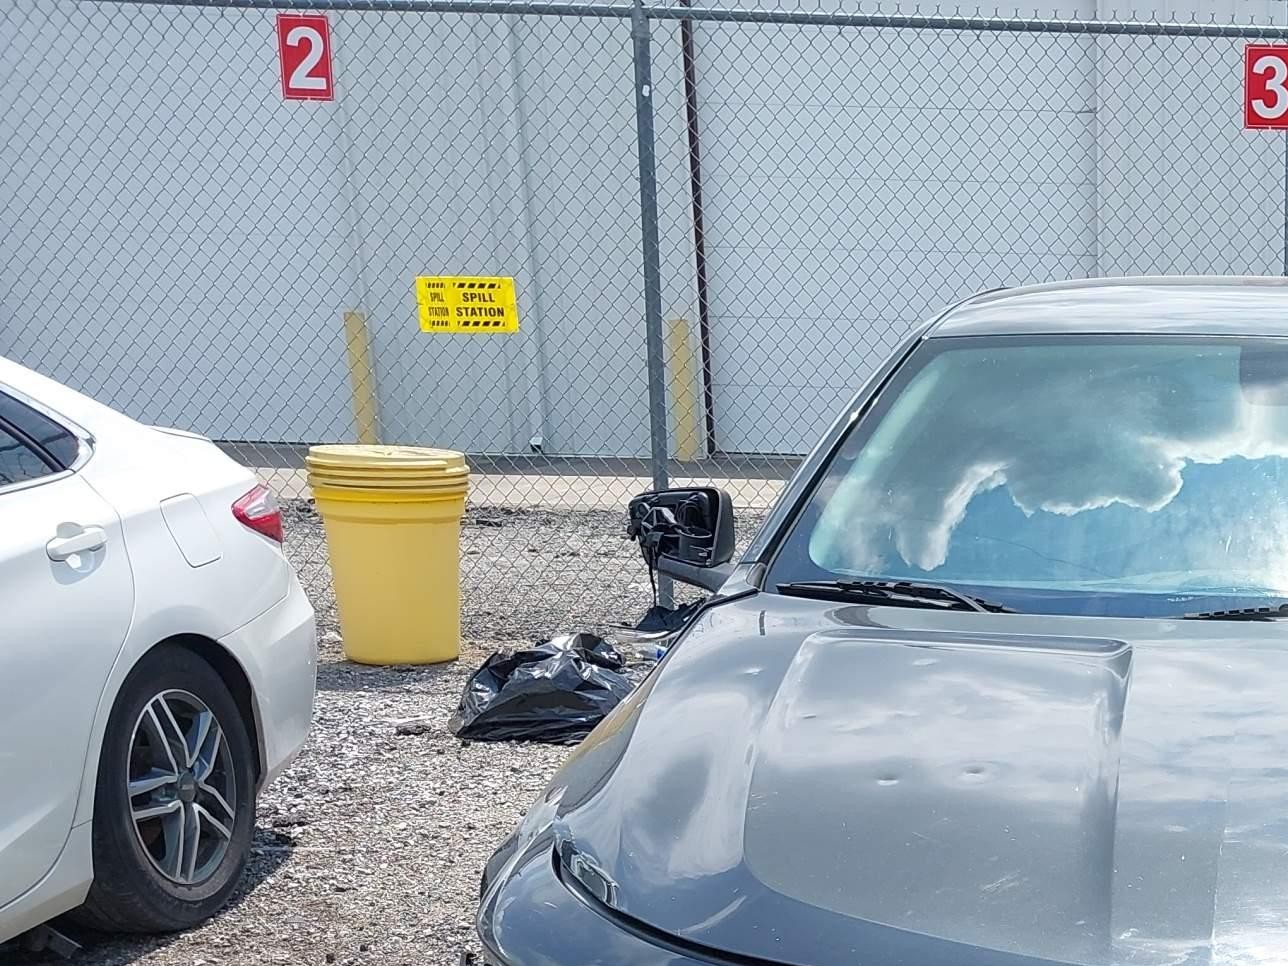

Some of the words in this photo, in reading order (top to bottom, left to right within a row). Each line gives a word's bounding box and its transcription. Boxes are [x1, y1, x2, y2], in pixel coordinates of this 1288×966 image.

[286, 26, 327, 90] 2
[430, 292, 445, 302] SPILL
[462, 292, 495, 303] SPILL
[428, 306, 449, 317] STATION
[456, 306, 505, 317] STATION
